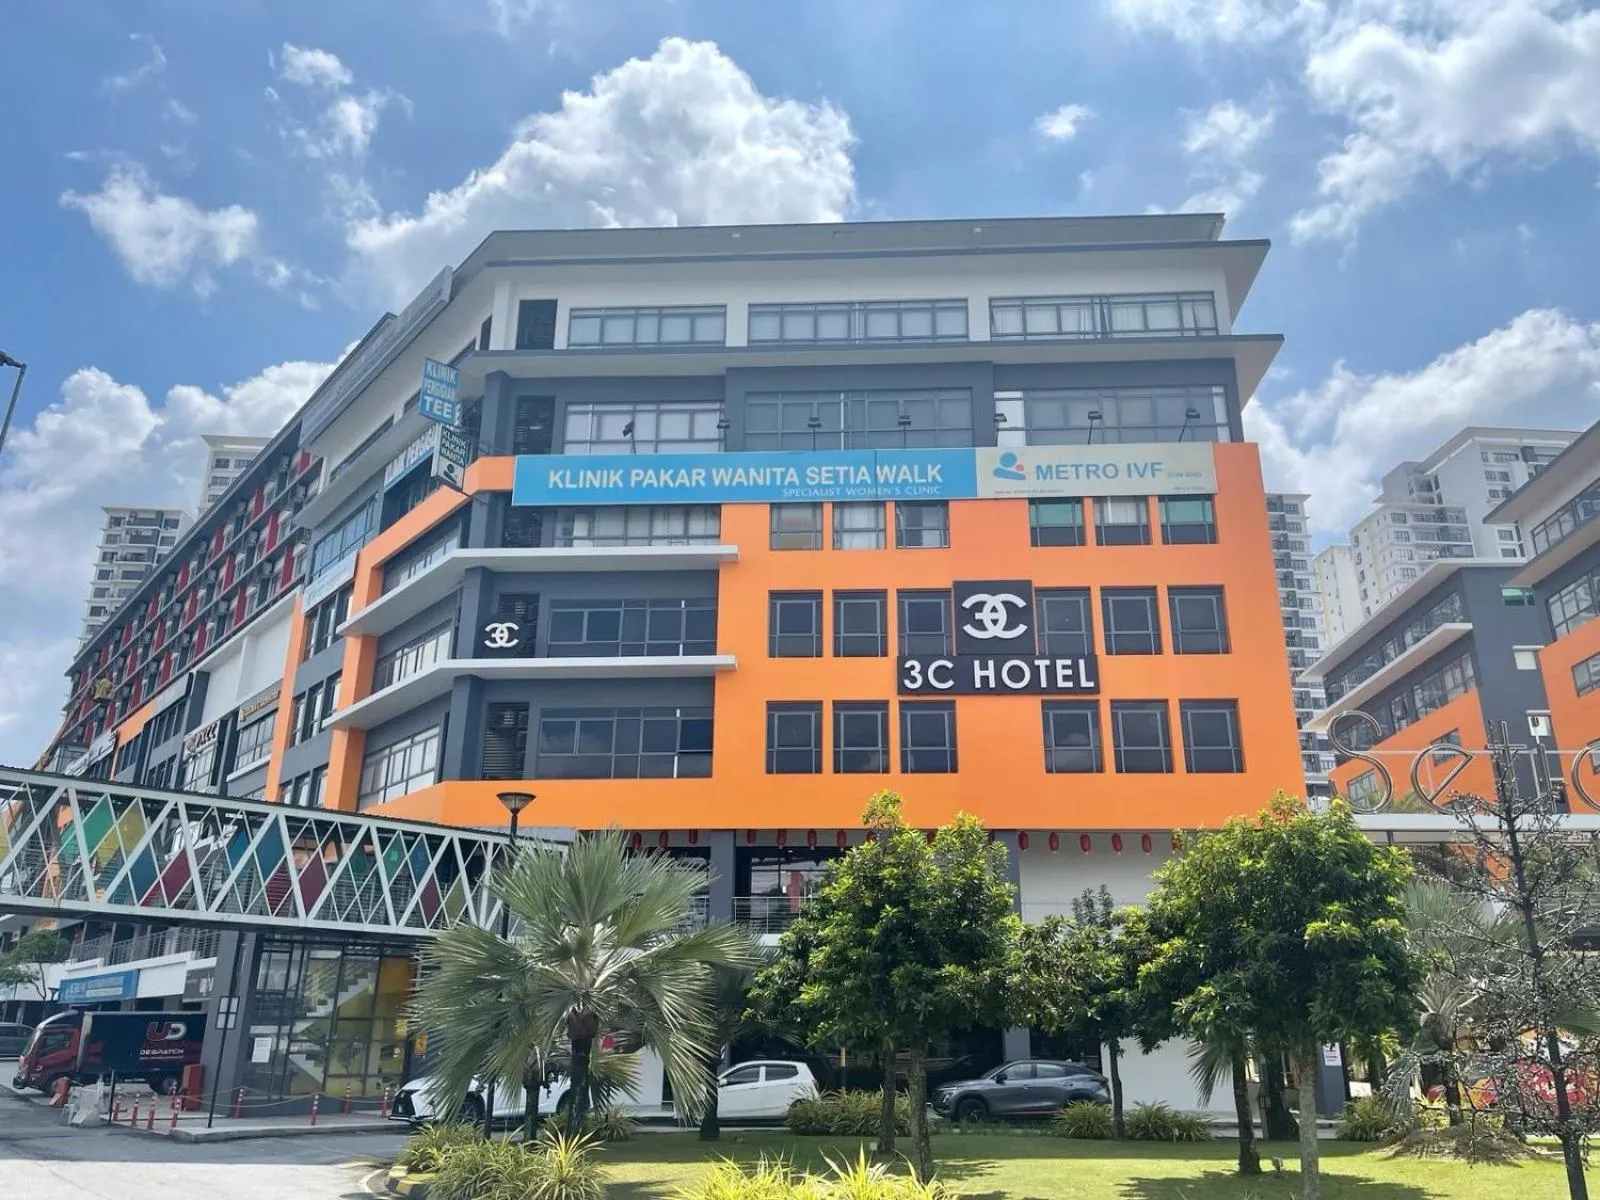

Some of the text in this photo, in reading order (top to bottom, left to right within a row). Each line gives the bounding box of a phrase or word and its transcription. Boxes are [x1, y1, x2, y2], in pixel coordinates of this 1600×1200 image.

[423, 396, 453, 419] TEE
[548, 464, 943, 489] KLINIK PAKAR WANITA SETIA WALK
[1035, 462, 1164, 481] METRO IVF
[782, 486, 942, 497] SPECIALIST WOMEN'S CLINIC
[903, 658, 1095, 690] 3C HOTEL
[147, 1021, 187, 1042] UD
